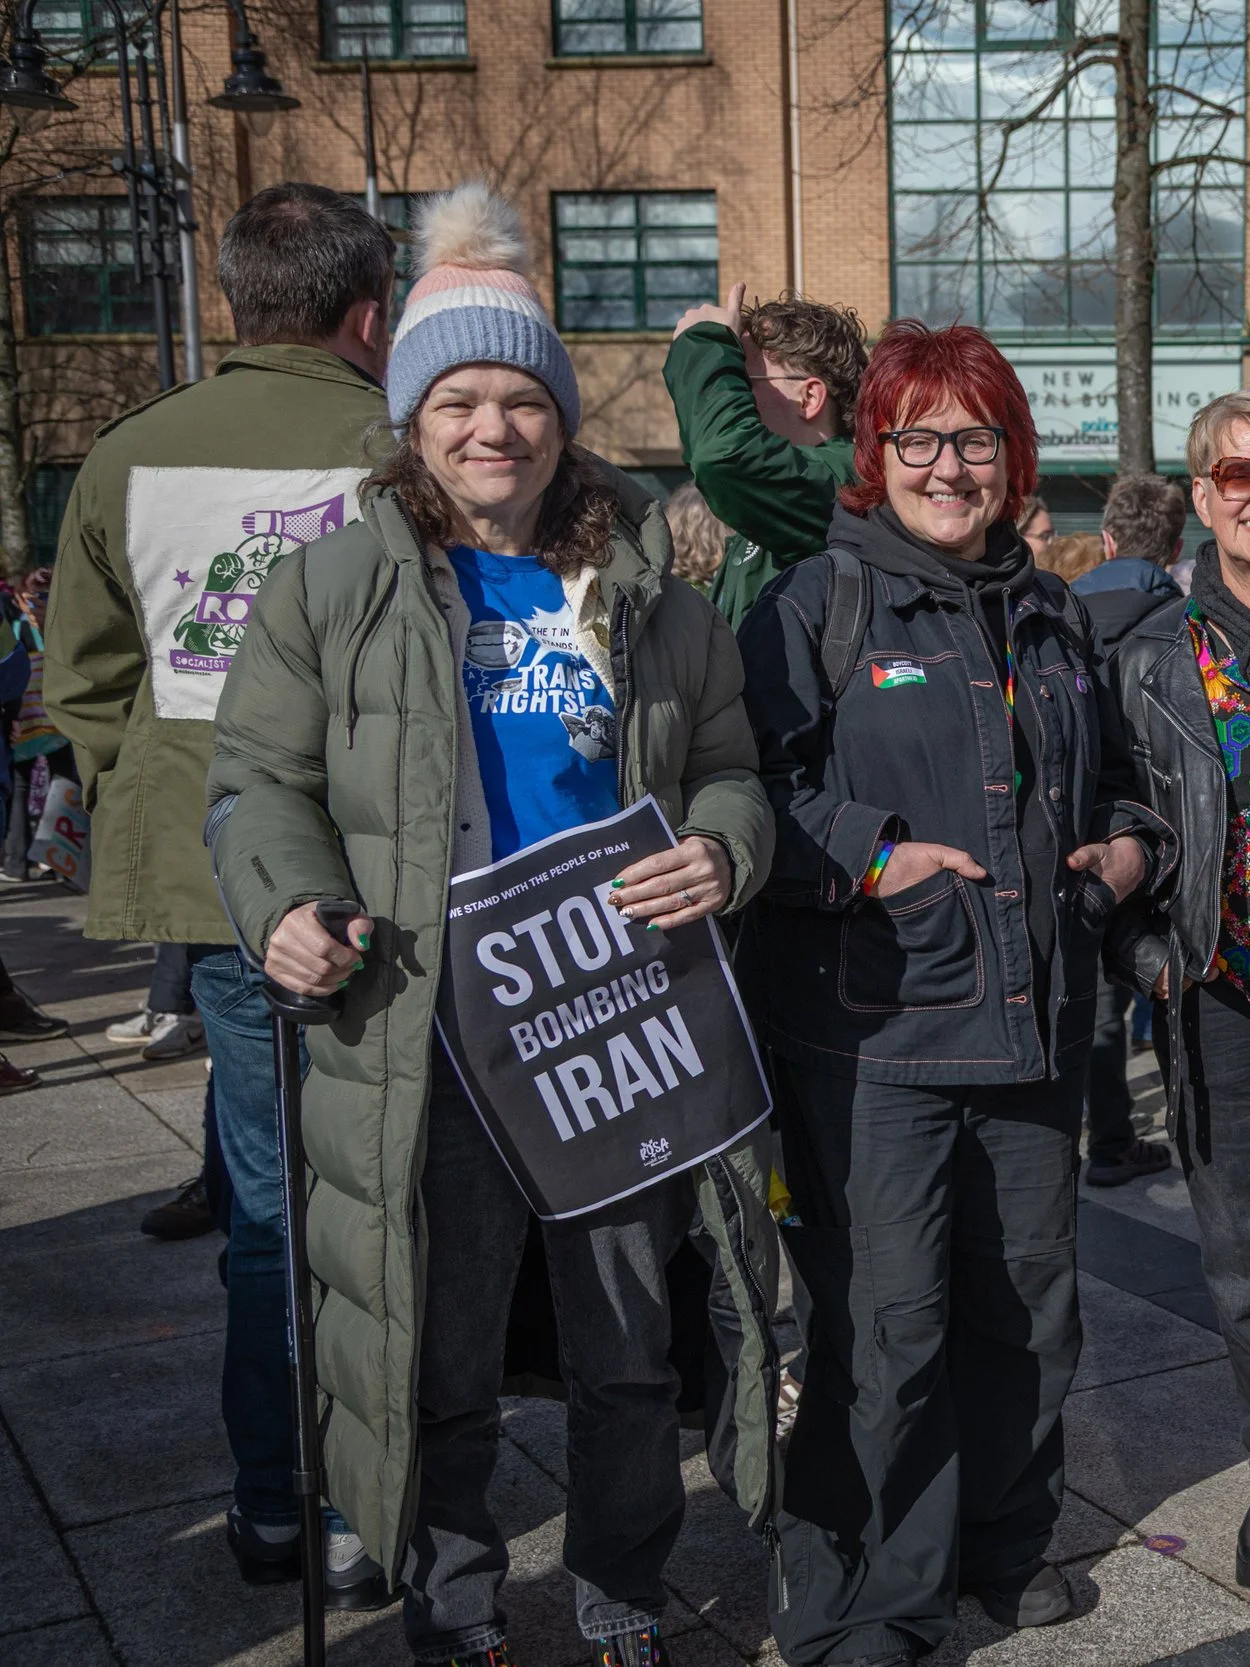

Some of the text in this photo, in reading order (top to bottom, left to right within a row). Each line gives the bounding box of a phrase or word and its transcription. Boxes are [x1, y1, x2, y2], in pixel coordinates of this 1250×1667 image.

[1043, 371, 1094, 387] NEW
[531, 626, 570, 637] THE T IN
[541, 638, 573, 651] STANDS
[175, 655, 225, 670] SOCIALIST
[517, 662, 596, 691] TRANS
[480, 689, 586, 714] RIGHTS!
[449, 841, 631, 919] WE STAND WITH THE PEOPLE OF IRAN
[509, 960, 670, 1063] BOMBING
[533, 1004, 705, 1143] IRAN
[640, 1137, 670, 1161] ROSA
